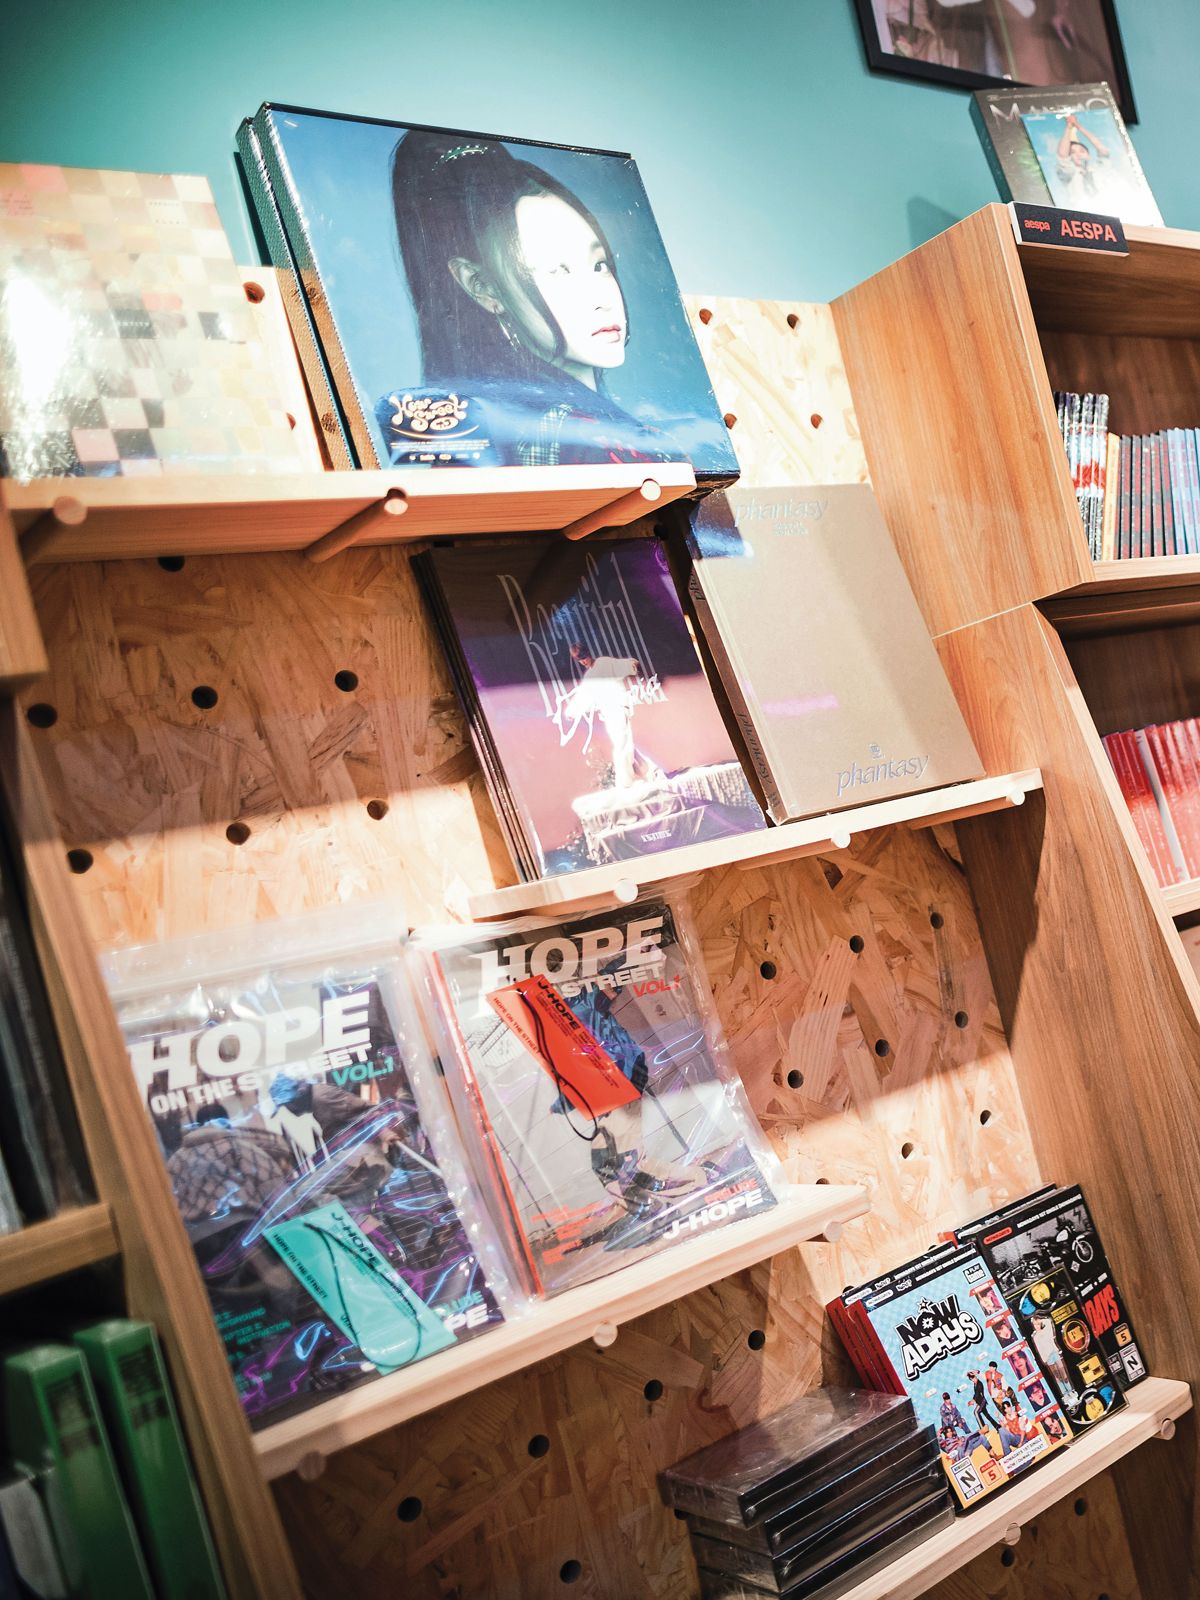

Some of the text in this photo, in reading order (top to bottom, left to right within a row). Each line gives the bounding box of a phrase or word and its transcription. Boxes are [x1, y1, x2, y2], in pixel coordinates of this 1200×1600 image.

[1024, 219, 1117, 242] aespa AESPA
[737, 711, 772, 784] phantasy
[837, 755, 929, 797] phantasy
[470, 916, 664, 1019] HOPE
[560, 959, 667, 998] STREET
[537, 981, 580, 1031] J-HOPE
[511, 1020, 524, 1034] THE
[129, 991, 371, 1108] HOPE
[332, 1056, 395, 1087] VOL.1
[151, 1089, 187, 1114] ON
[189, 1079, 235, 1104] THE
[662, 1188, 763, 1240] J-HOPE
[896, 1293, 960, 1344] NOW
[1119, 1332, 1128, 1342] 5
[901, 1311, 984, 1380] ADAYS
[1124, 1353, 1140, 1371] N
[957, 1467, 978, 1490] N
[986, 1468, 997, 1481] 5
